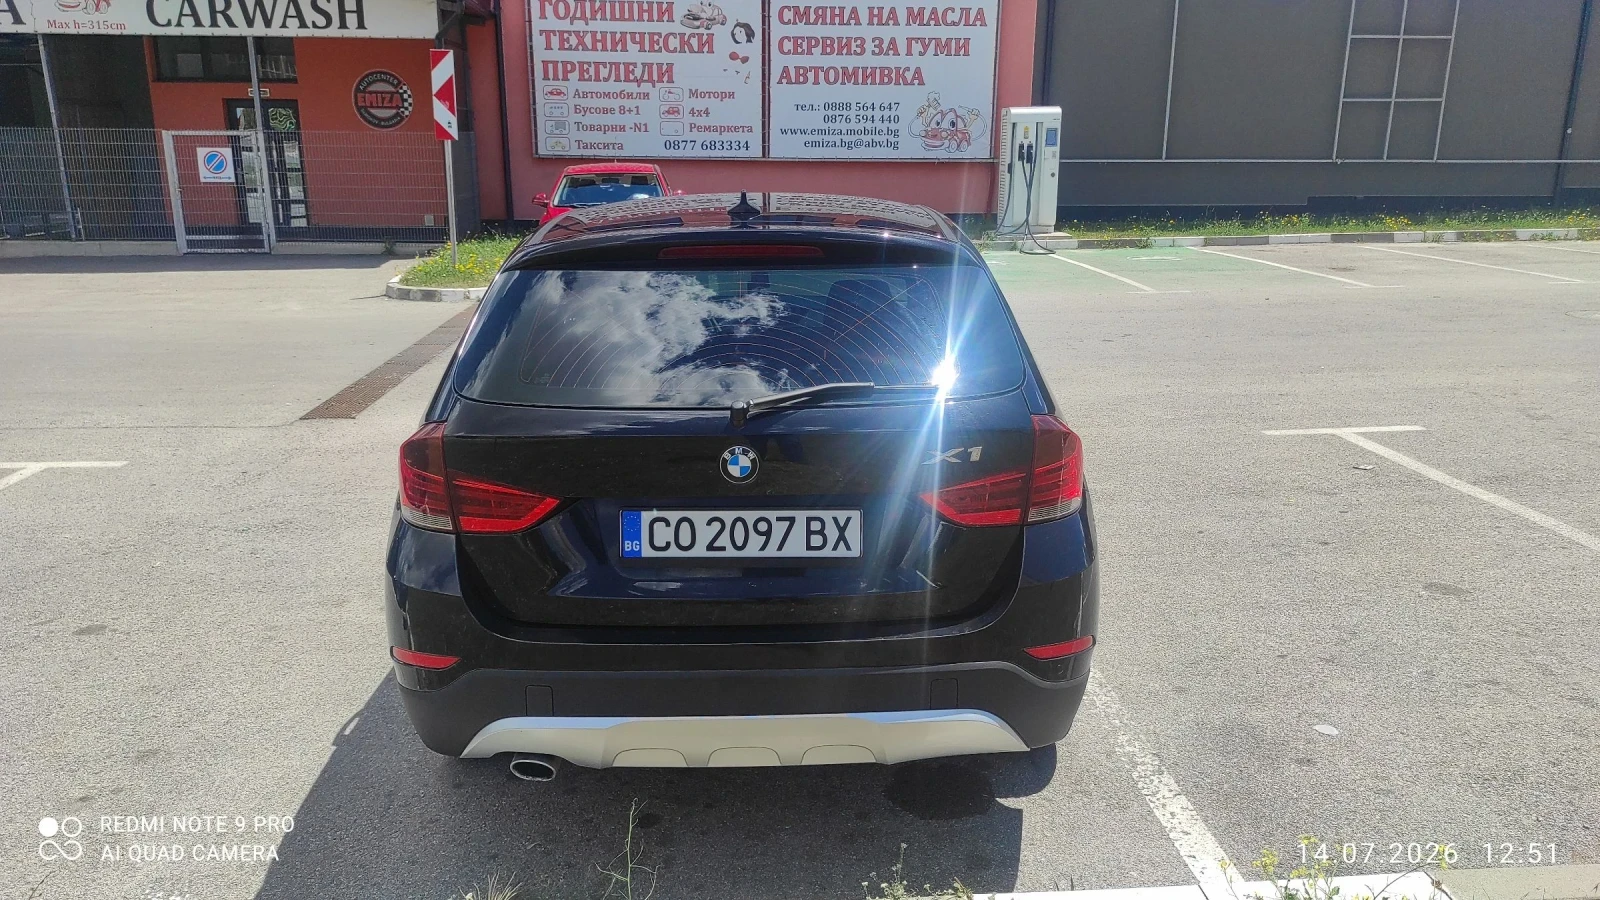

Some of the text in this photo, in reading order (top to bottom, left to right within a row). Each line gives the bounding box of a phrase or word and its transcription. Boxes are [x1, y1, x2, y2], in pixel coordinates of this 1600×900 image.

[145, 0, 368, 30] CARWASH
[538, 0, 676, 26] ГОДИШНИ
[777, 5, 988, 27] СМЯНА НА МАСЛА
[47, 20, 127, 30] Max h=315cm
[539, 29, 715, 54] ТЕХНИЧЕСКИ
[777, 35, 971, 57] СЕРВИЗ ЗА ГУМИ
[541, 60, 675, 88] ПРЕГЛЕДИ
[776, 65, 925, 86] АВТОМИВКА
[359, 73, 398, 90] AUTOCENTER
[357, 92, 403, 107] EMIZA
[573, 88, 650, 100] Автомобили
[688, 88, 735, 101] Мотори
[573, 104, 641, 117] Бусове 8+1
[794, 102, 900, 112] тел.: 0888 564 647
[823, 114, 900, 124] 0876 594 440
[574, 121, 650, 134] Товарни -N1
[689, 122, 754, 135] Ремаркета
[779, 126, 900, 138] www.emiza.mobile.bg
[574, 140, 624, 151] Таксита
[664, 140, 751, 151] 0877 683334
[804, 138, 900, 150] emiza.bg@abv.bg
[723, 447, 756, 460] BMW
[921, 446, 983, 465] X1
[705, 515, 797, 552] 2097
[804, 515, 853, 552] BX
[624, 540, 641, 552] BG
